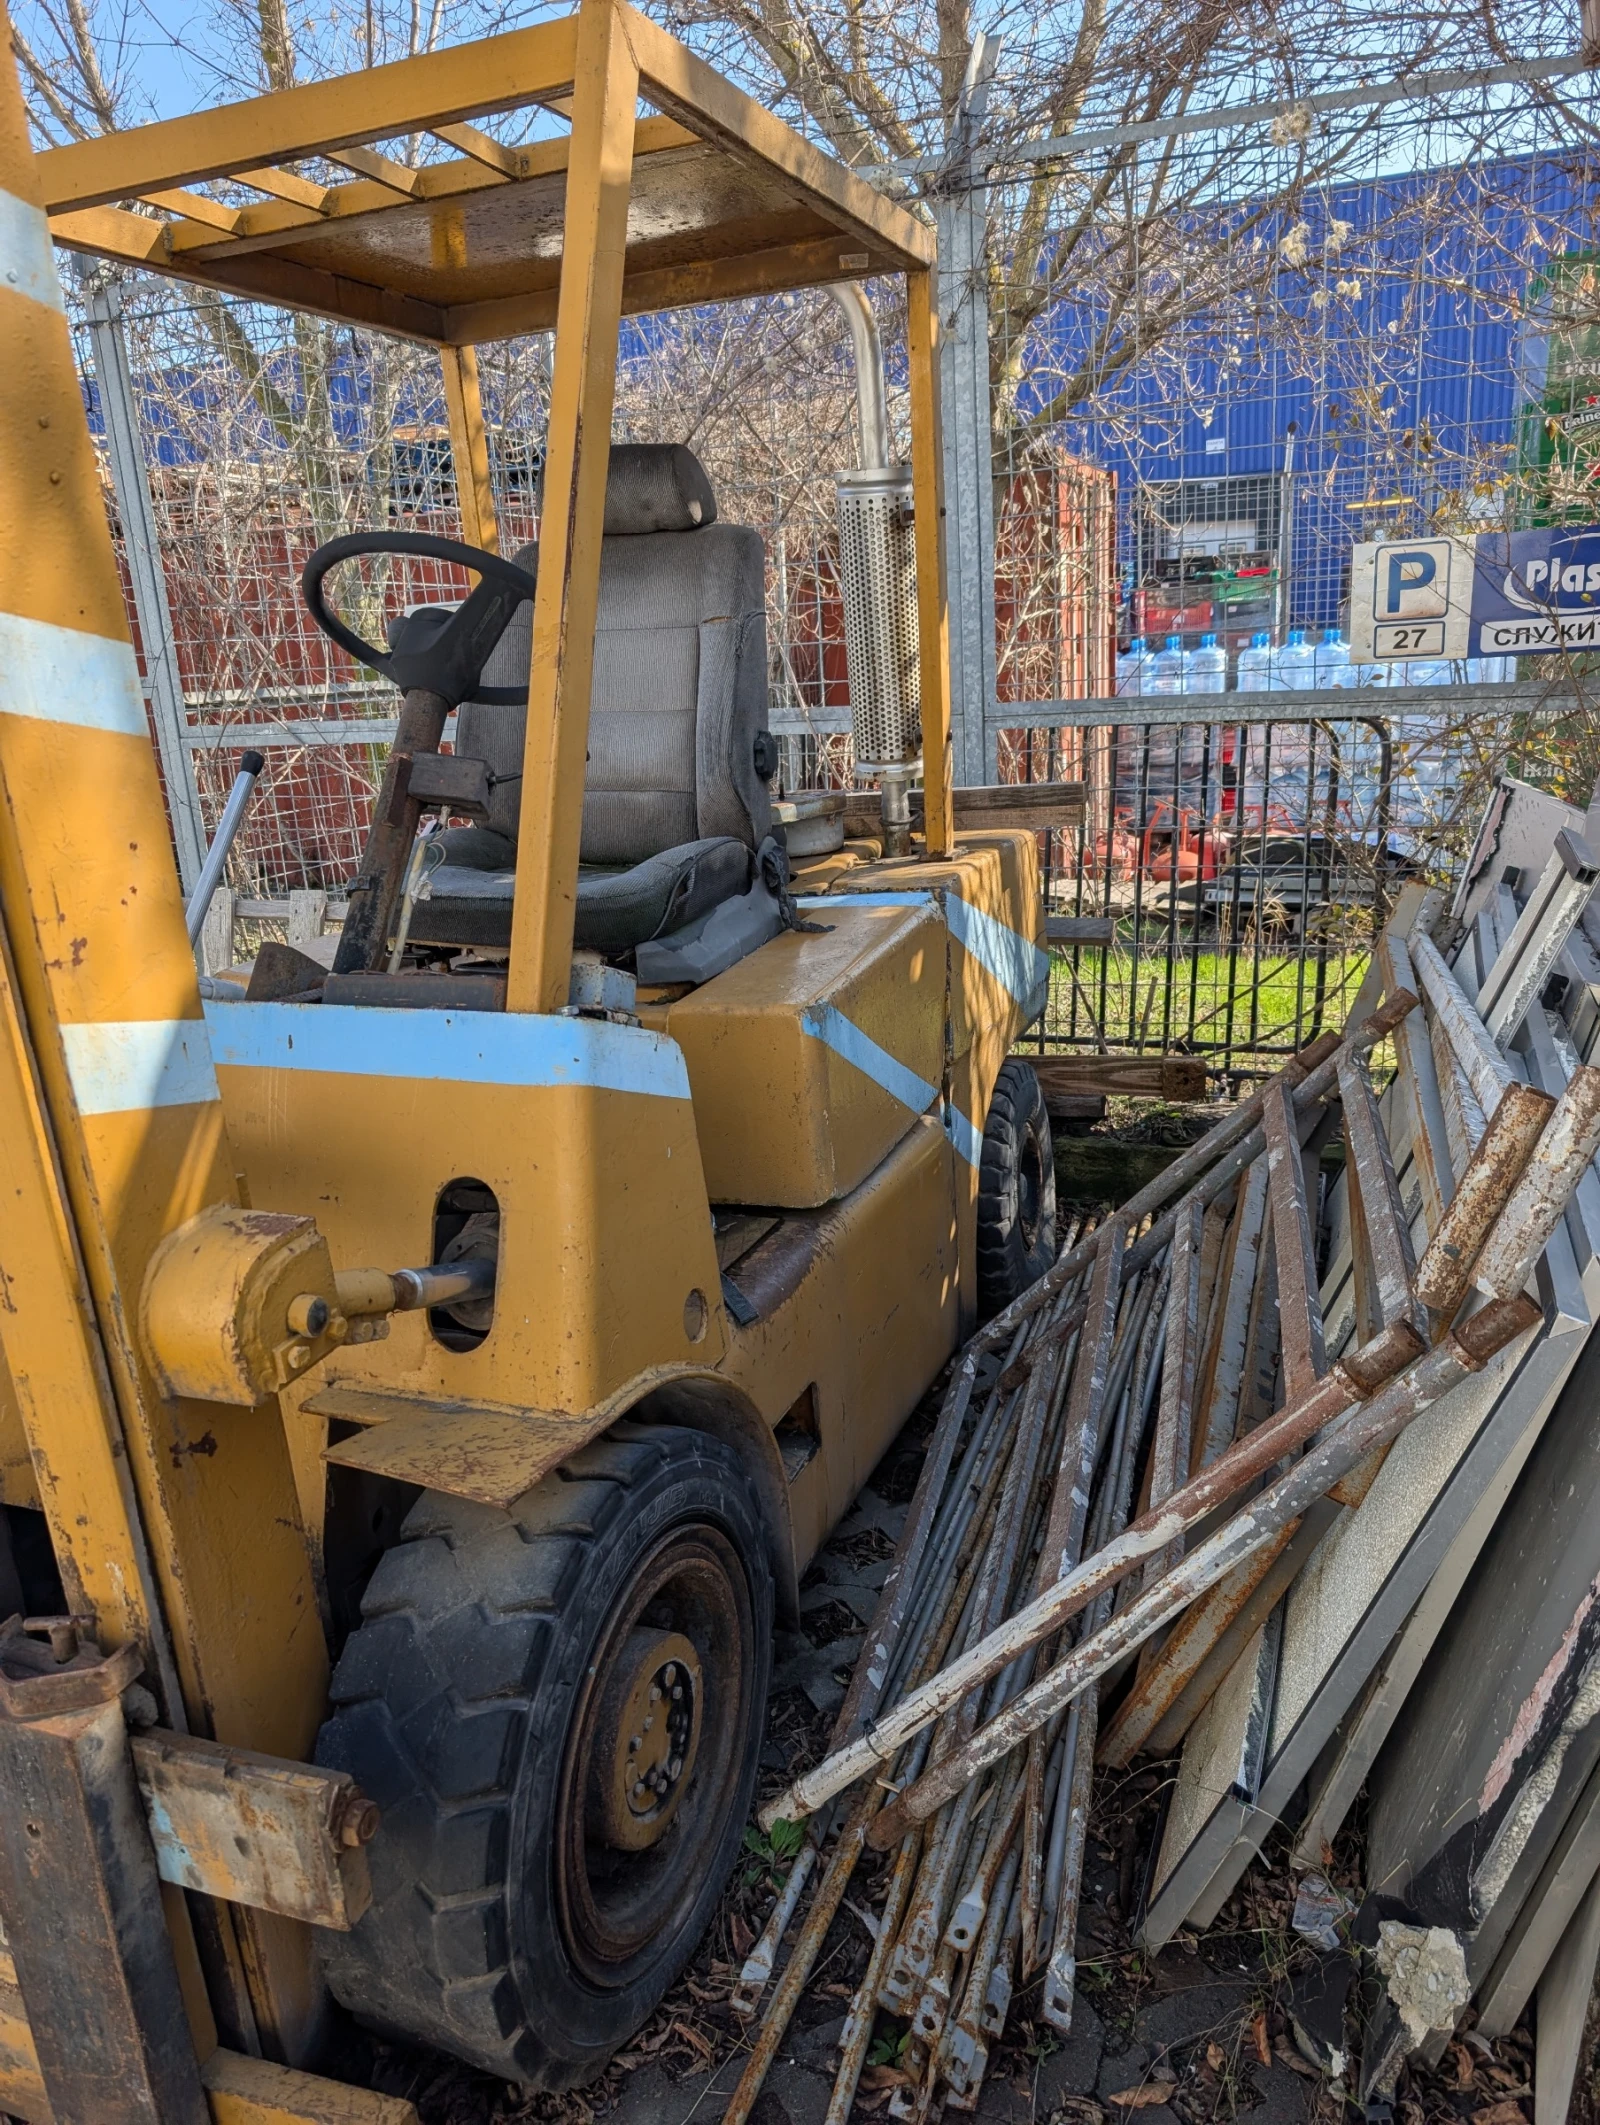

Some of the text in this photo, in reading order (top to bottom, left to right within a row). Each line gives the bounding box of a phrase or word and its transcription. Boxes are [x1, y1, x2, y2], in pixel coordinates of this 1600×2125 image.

[1387, 551, 1437, 614] P
[1526, 557, 1600, 593] Plas
[1393, 628, 1427, 650] 27
[1494, 621, 1600, 646] СЛУЖИ
